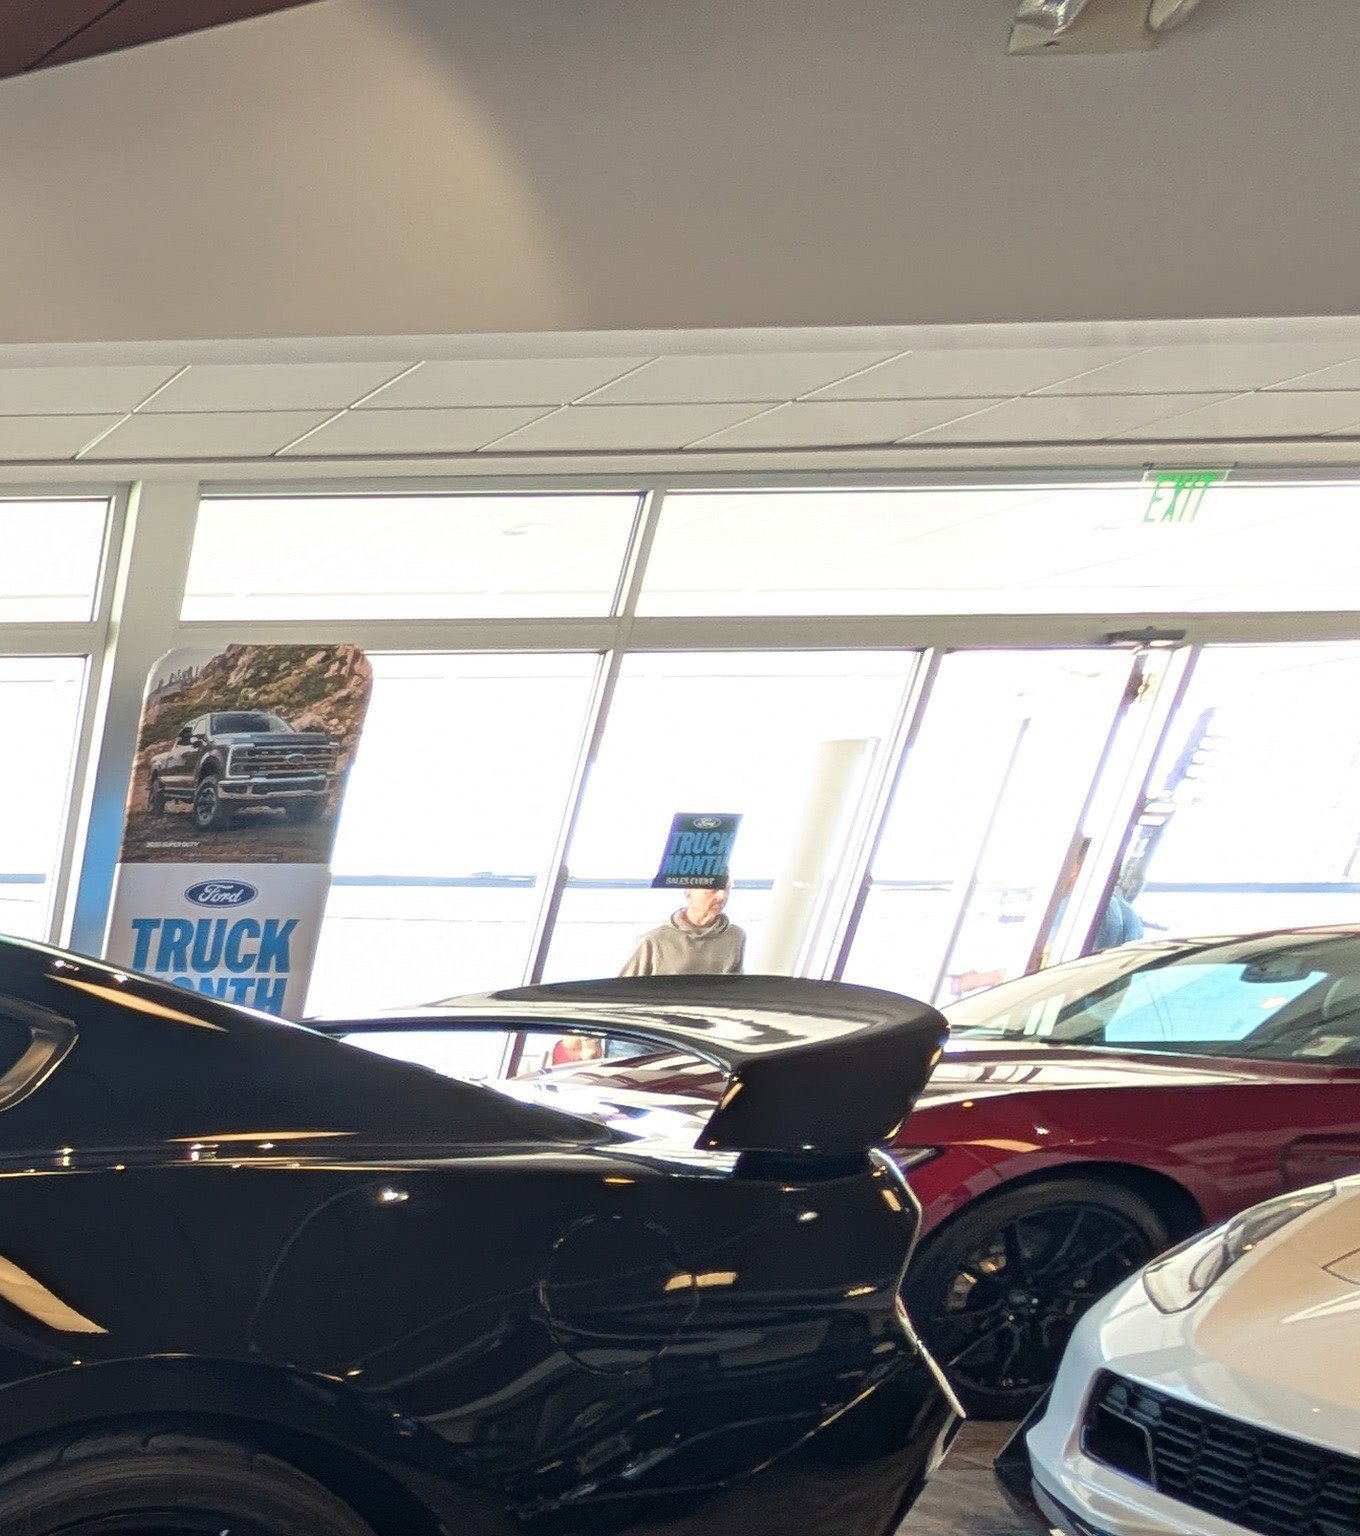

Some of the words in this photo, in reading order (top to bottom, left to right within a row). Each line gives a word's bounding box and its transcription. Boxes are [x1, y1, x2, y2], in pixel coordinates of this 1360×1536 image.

[1143, 473, 1218, 522] EXIT
[670, 831, 734, 854] TRUCK
[662, 855, 725, 876] MONTH
[198, 884, 244, 903] Ford
[131, 917, 301, 974] TRUCK
